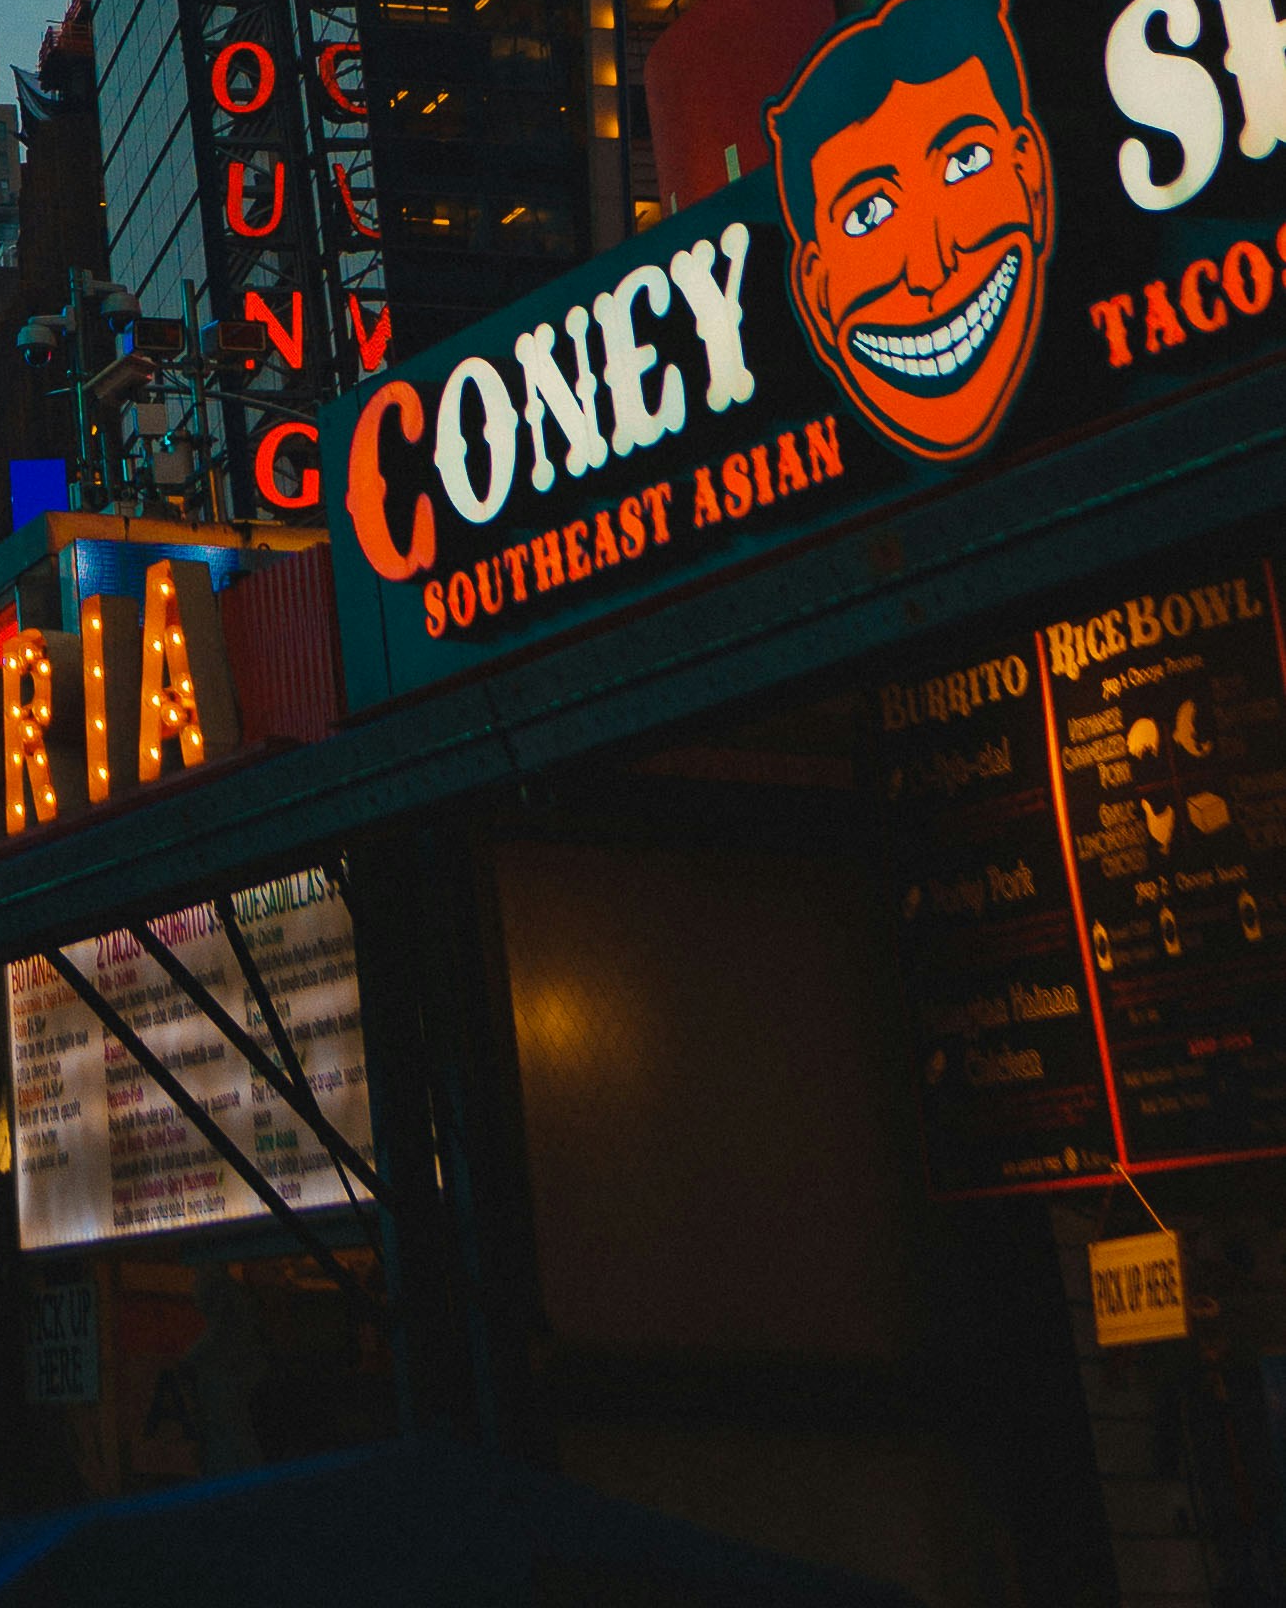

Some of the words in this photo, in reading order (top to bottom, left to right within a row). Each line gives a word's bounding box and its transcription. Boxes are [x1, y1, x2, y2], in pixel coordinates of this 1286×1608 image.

[1089, 221, 1286, 369] TACO
[347, 222, 755, 582] CONEY
[424, 480, 672, 639] SOUTHEAST
[691, 414, 845, 528] ASIAN
[880, 654, 1029, 732] BURRITO
[1045, 609, 1127, 682] RICE
[1124, 578, 1263, 649] BOWL
